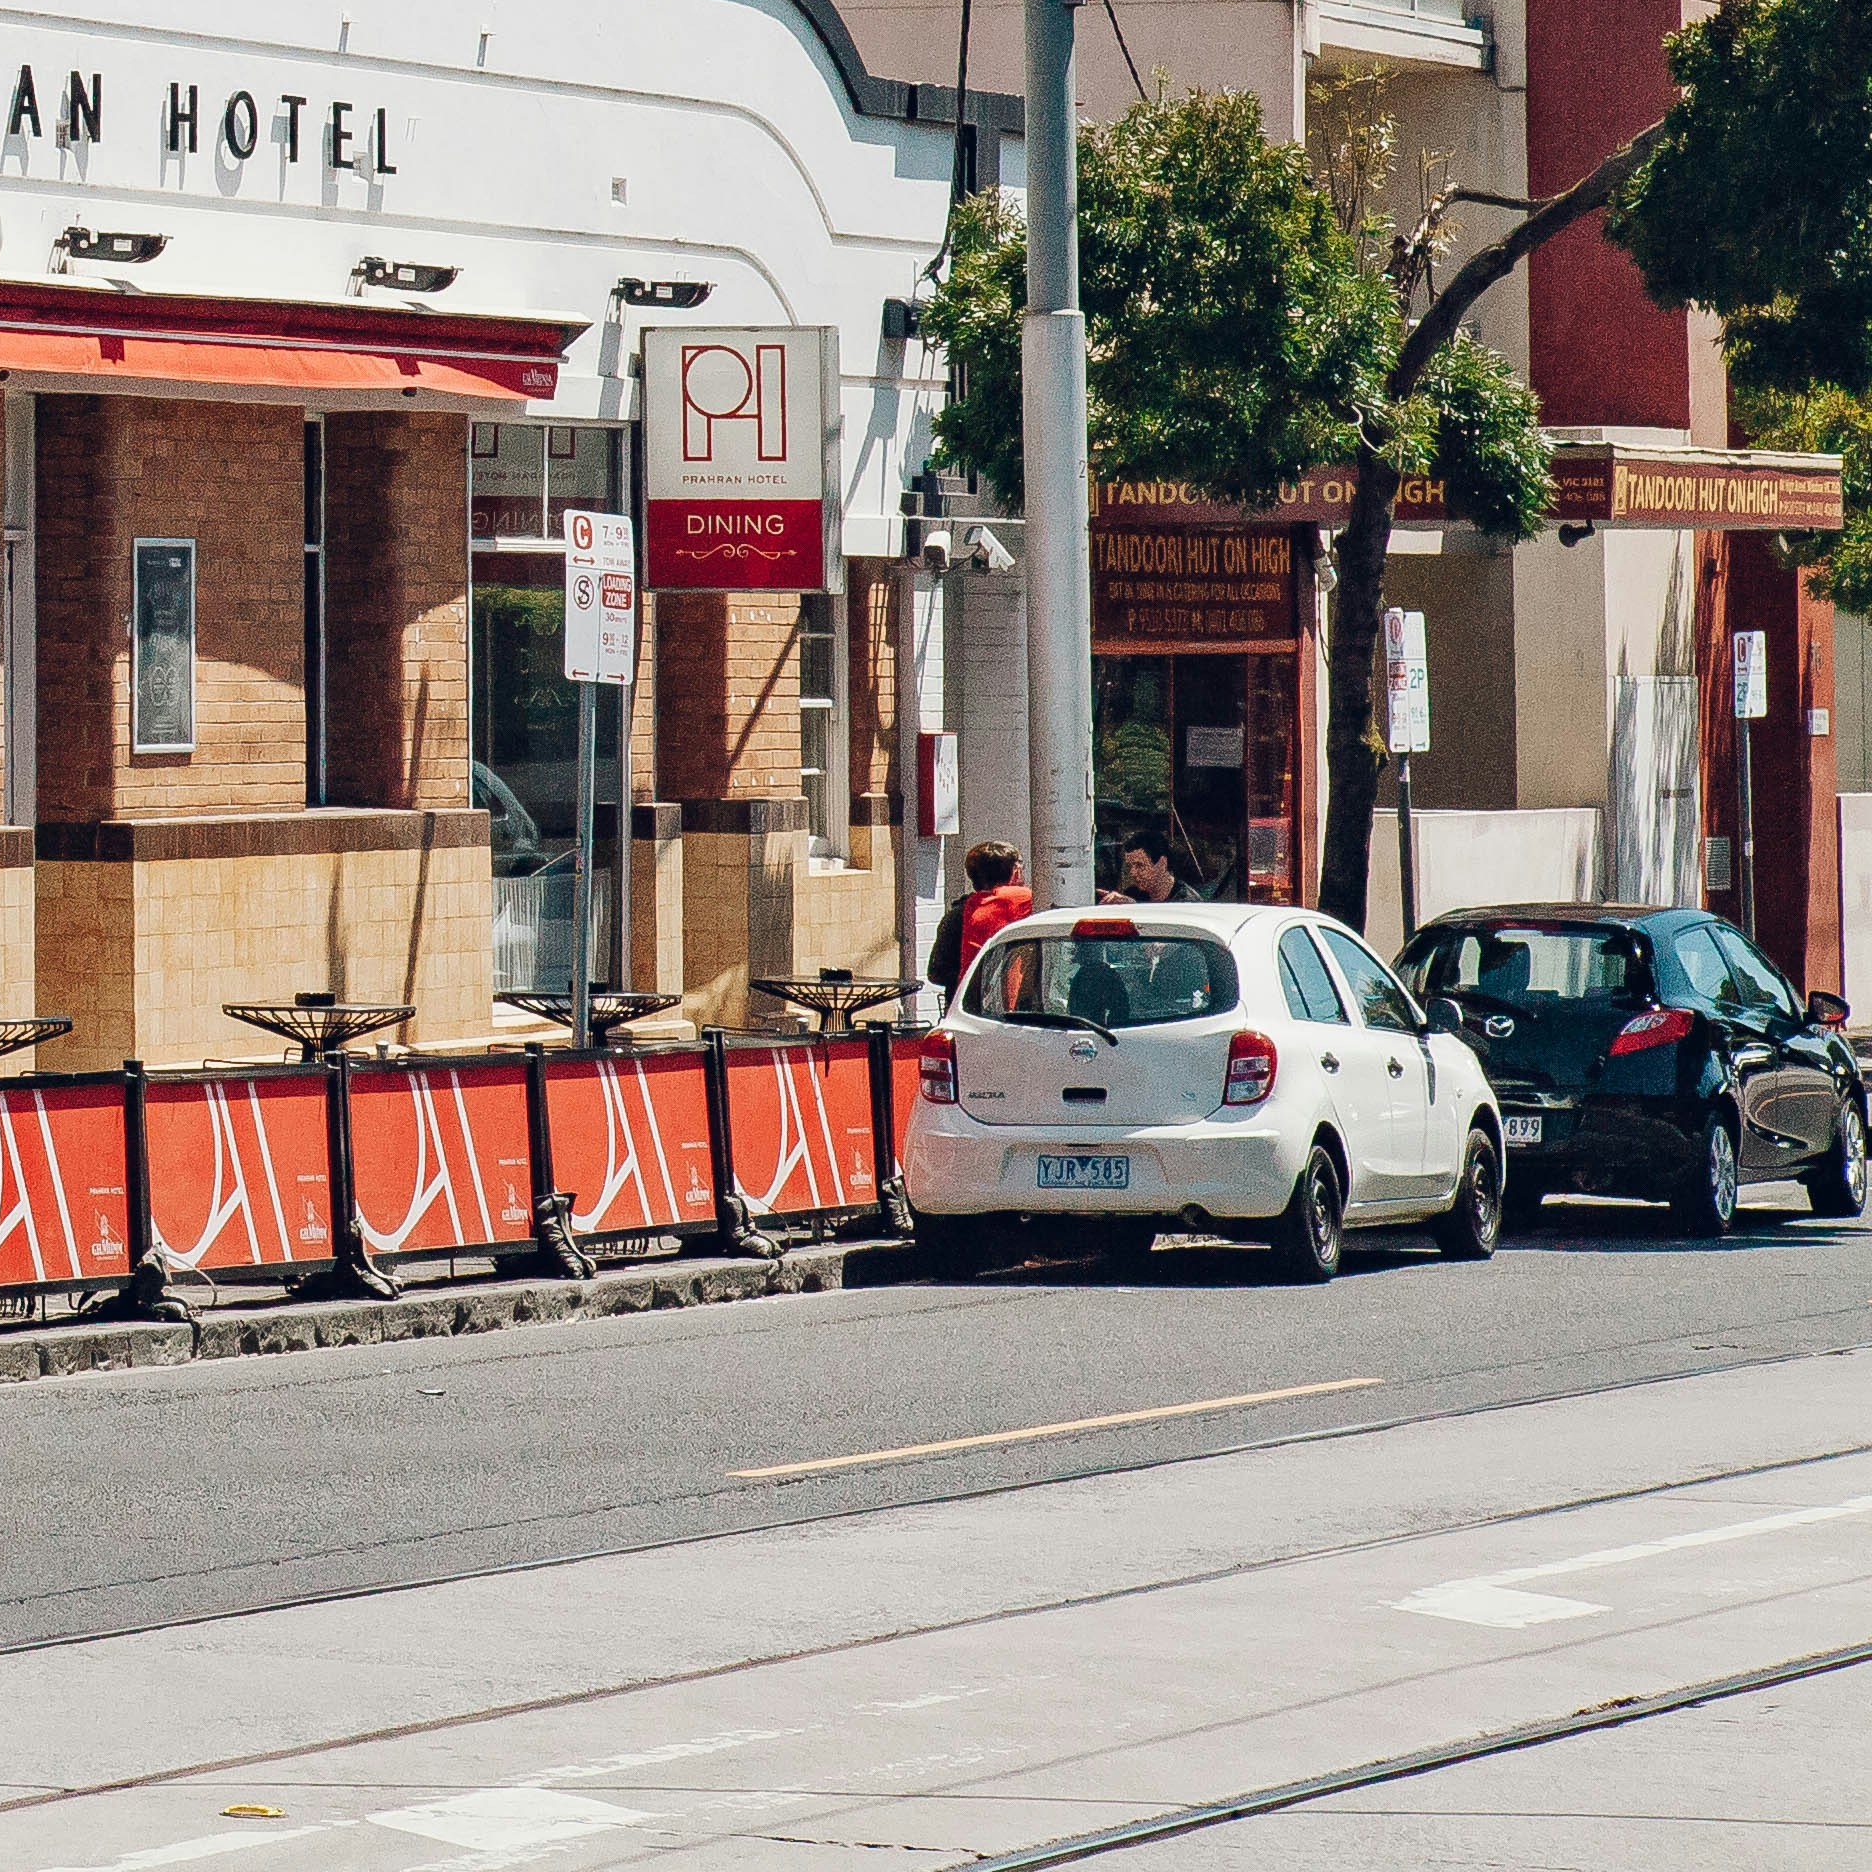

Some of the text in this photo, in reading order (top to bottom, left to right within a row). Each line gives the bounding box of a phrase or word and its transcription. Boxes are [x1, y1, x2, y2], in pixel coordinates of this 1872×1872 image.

[168, 81, 398, 175] HOTEL
[682, 474, 788, 485] PRAHRAN HOTEL
[1627, 474, 1696, 512] TANDOORI
[1698, 477, 1726, 513] HUT
[687, 514, 785, 535] DINING
[1095, 533, 1291, 575] TANDOORI HUT ON HIGH
[603, 575, 633, 592] LOADING
[605, 592, 628, 608] ZONE
[1409, 668, 1425, 689] 2P
[1041, 1159, 1077, 1180] YJR
